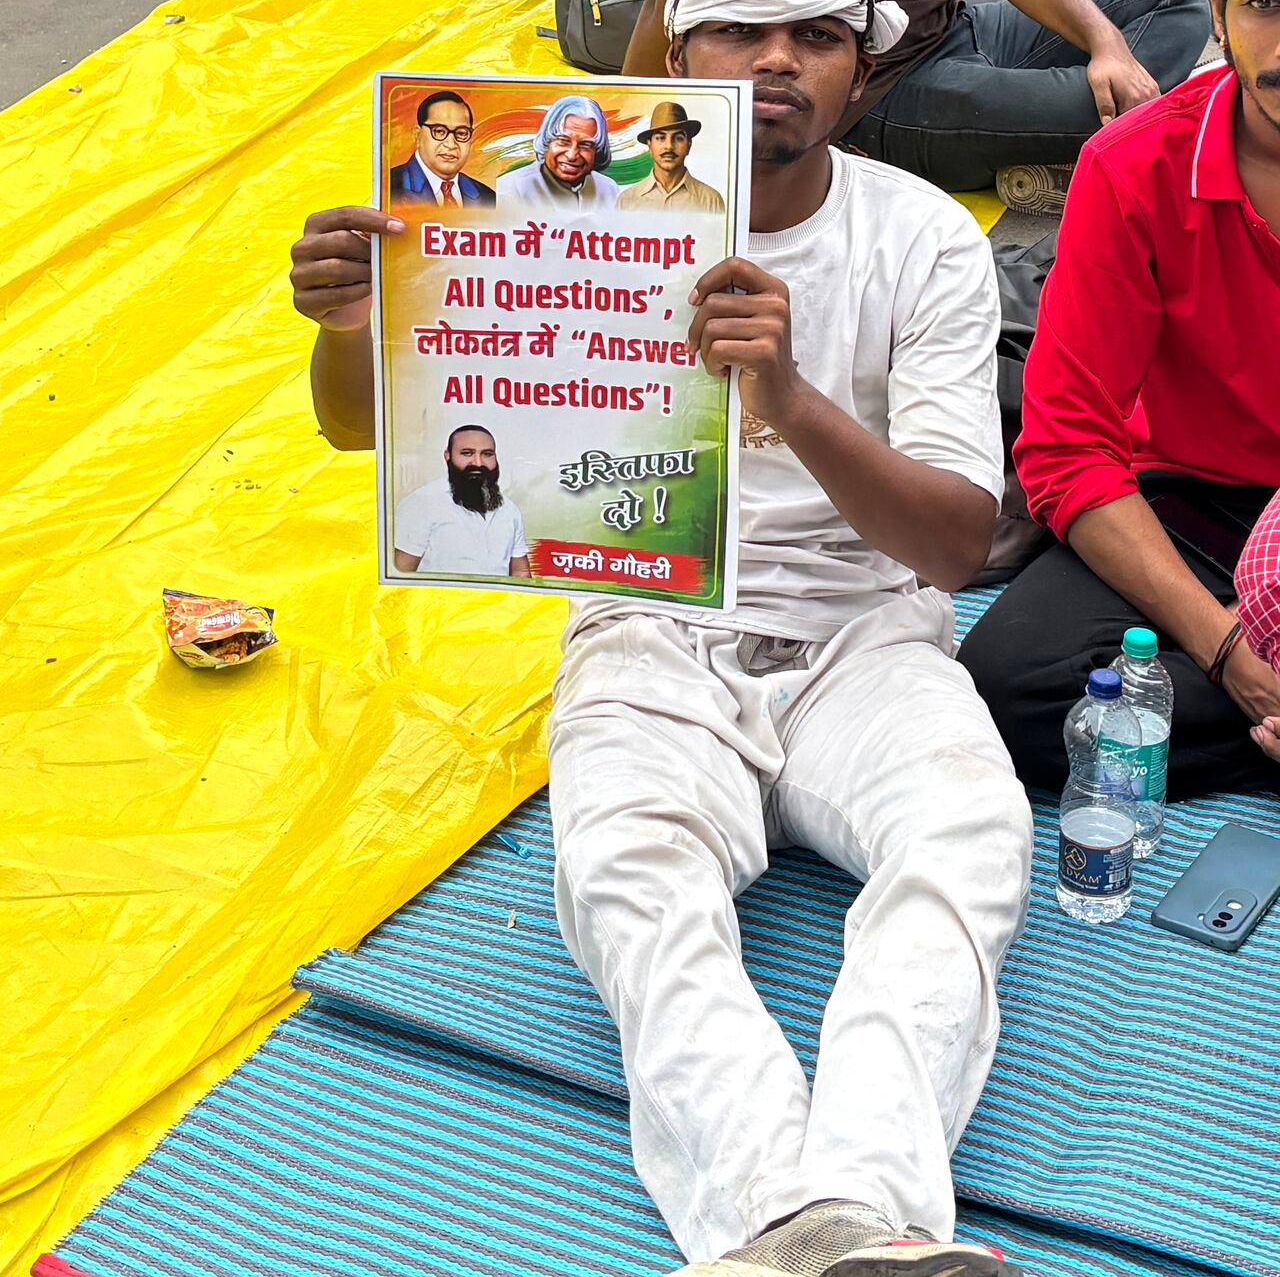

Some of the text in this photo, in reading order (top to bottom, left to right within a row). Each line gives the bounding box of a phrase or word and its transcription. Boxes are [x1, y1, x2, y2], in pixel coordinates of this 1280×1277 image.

[424, 225, 505, 257] Exam
[515, 222, 546, 260] में
[444, 278, 485, 308] All
[414, 321, 522, 358] लोकतंत्र
[528, 322, 560, 358] में
[444, 376, 483, 404] All
[560, 448, 695, 488] इस्तिफा
[609, 555, 672, 580] गौहरी
[199, 612, 241, 628] Diamond
